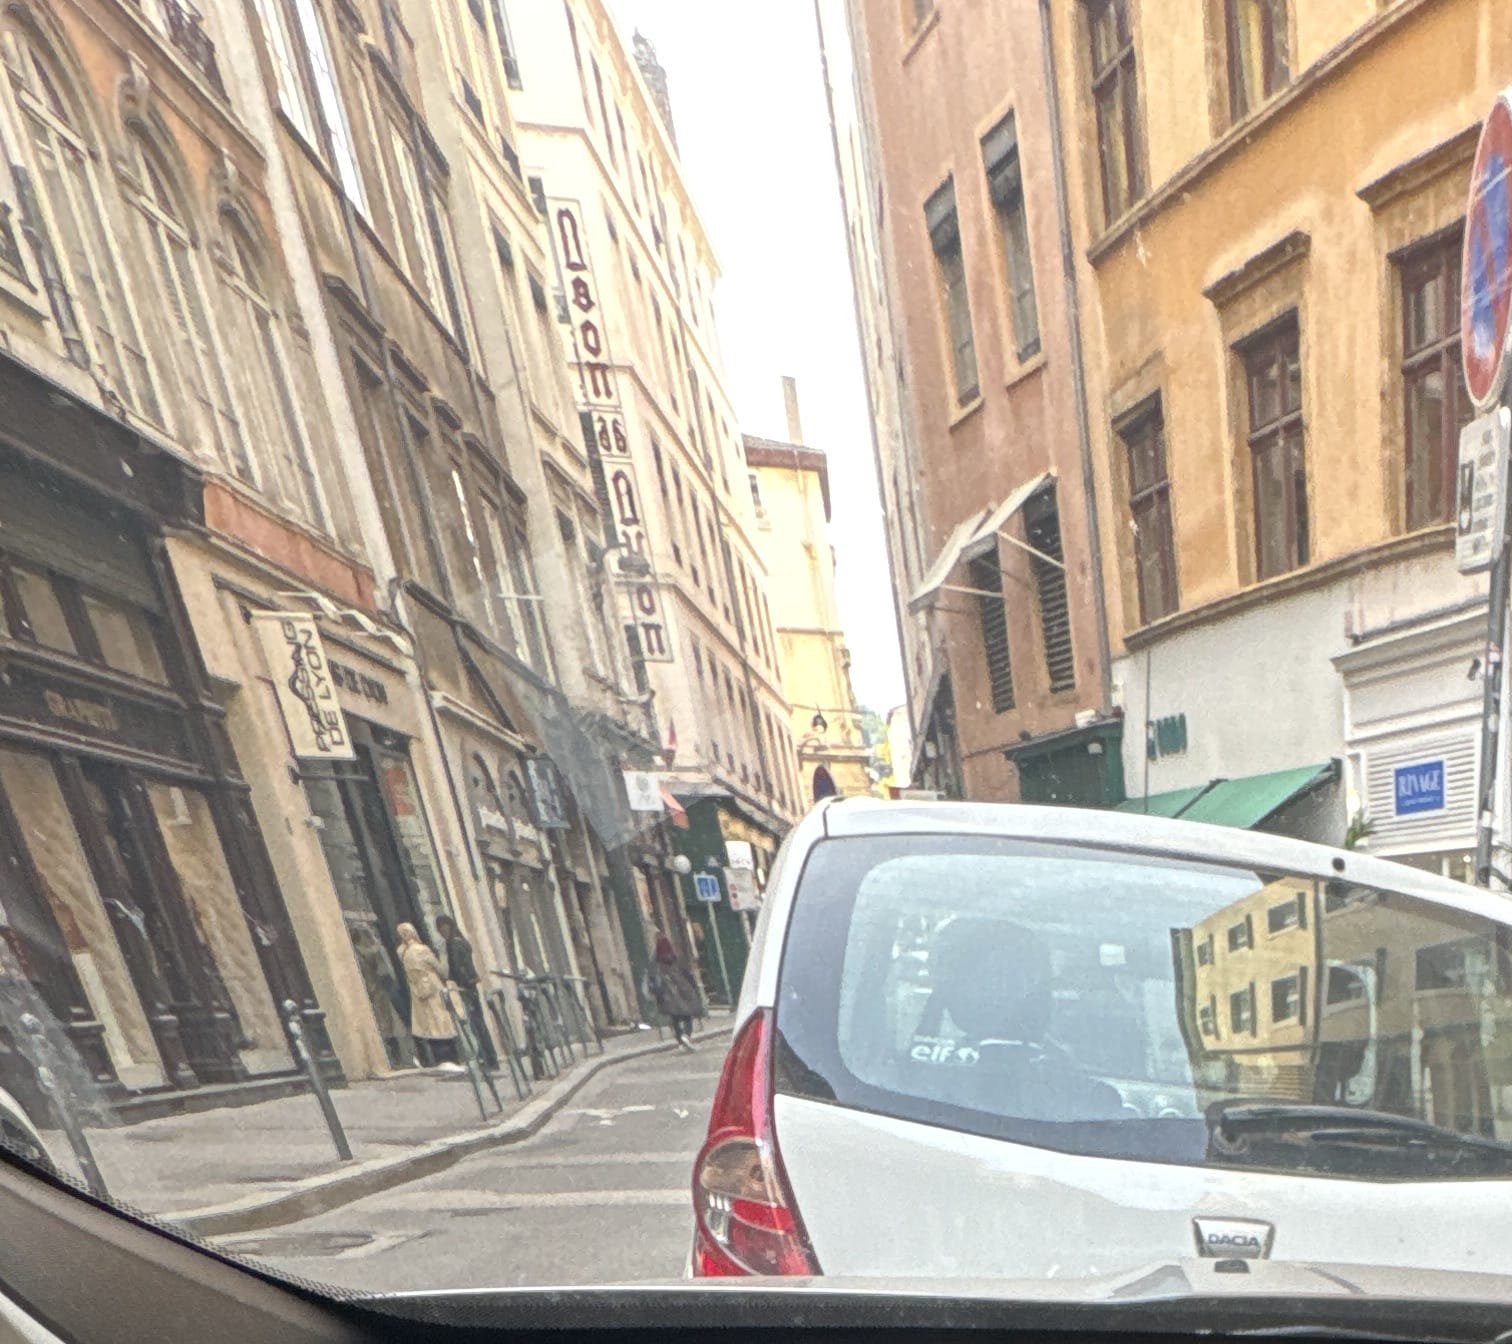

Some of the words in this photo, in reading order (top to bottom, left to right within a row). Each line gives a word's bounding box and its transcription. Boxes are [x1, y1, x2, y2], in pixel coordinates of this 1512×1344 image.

[300, 629, 332, 700] LYON
[324, 710, 345, 746] DE
[1398, 770, 1441, 797] RIVAGE
[911, 1045, 954, 1064] elf
[1208, 1233, 1259, 1247] DACIA
